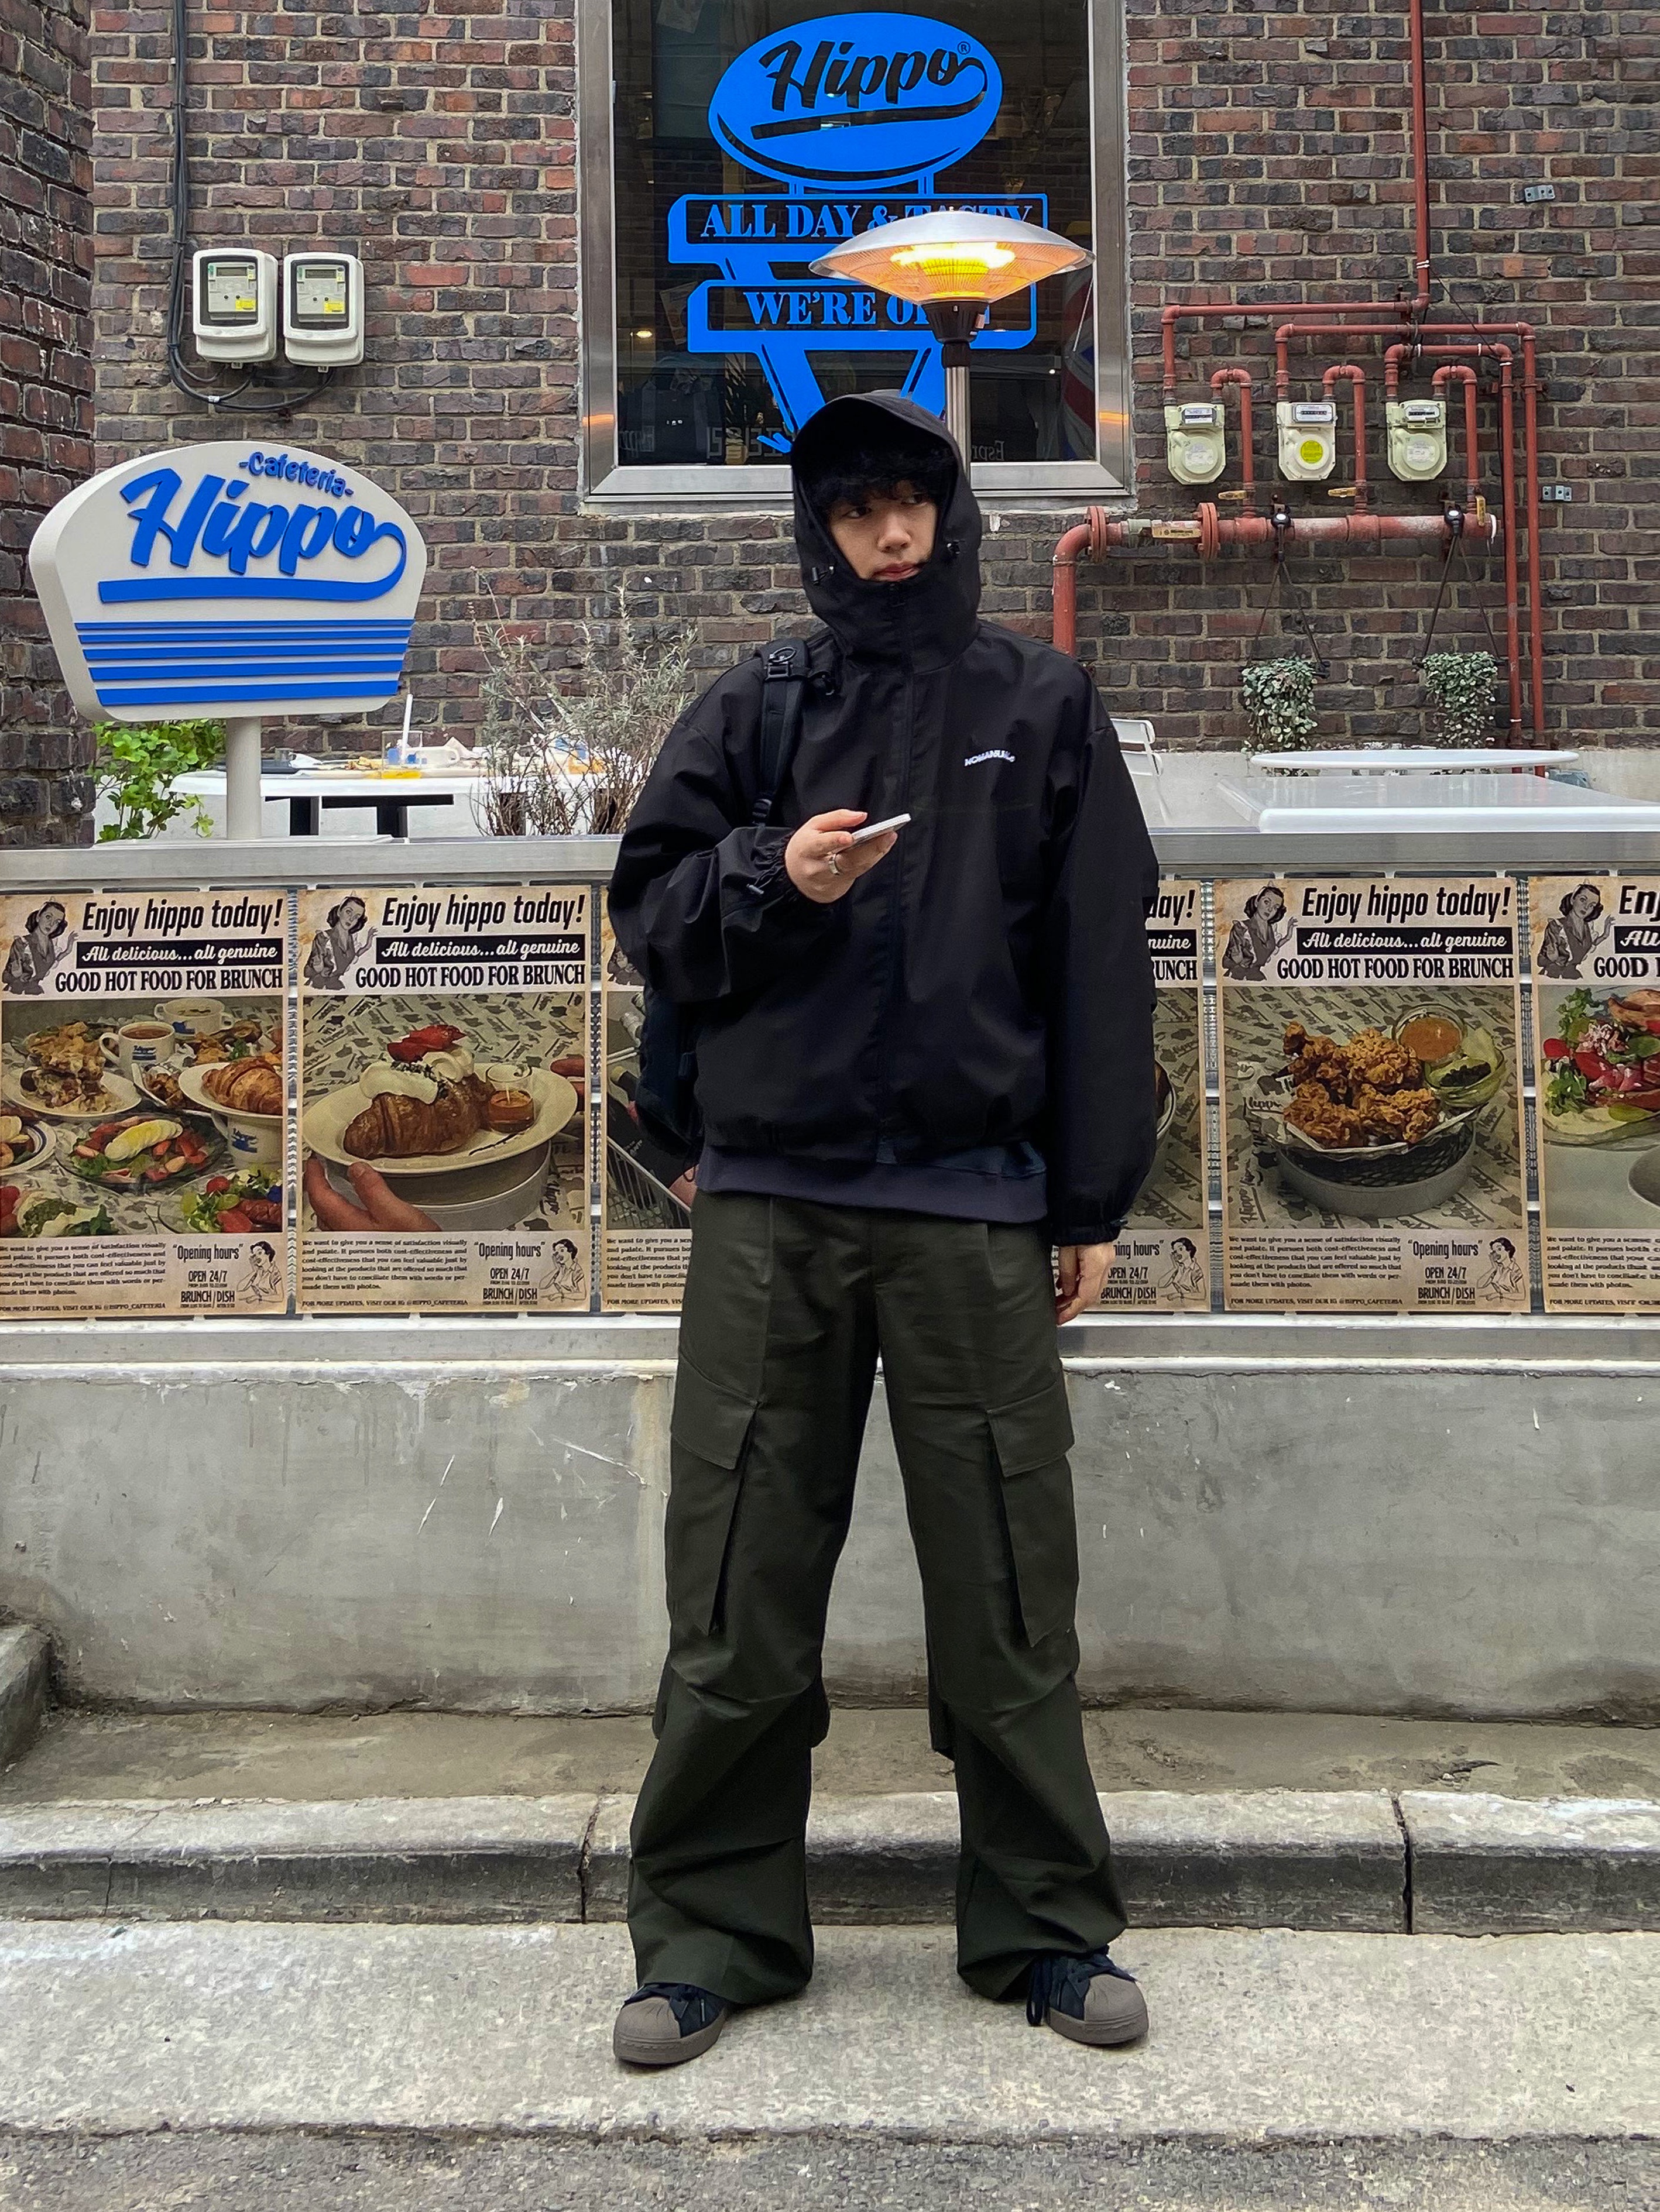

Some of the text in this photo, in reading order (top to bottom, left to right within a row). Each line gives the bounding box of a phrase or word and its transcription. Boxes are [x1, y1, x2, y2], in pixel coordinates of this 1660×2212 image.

[759, 40, 973, 112] Hippo
[701, 205, 776, 238] ALL
[786, 205, 862, 238] DAY
[743, 292, 876, 325] WE’RE
[120, 468, 389, 576] Hippo
[382, 892, 585, 933] Enjoy hippo today!
[1301, 884, 1511, 925] Enjoy hippo today!
[83, 897, 284, 937] Enjoy hippo today!
[381, 940, 410, 958] All
[520, 940, 581, 961] genuine
[1302, 933, 1330, 949] All
[1445, 932, 1507, 953] genuine
[82, 944, 109, 962] All
[218, 944, 278, 964] genuine
[356, 964, 585, 988] GOOD HOT FOOD FOR BRUNCH
[1153, 960, 1198, 981] UNCH
[1277, 958, 1514, 979] GOOD HOT FOOD FOR BRUNCH
[1594, 957, 1649, 978] GOOD
[56, 968, 283, 992] GOOD HOT FOOD FOR BRUNCH
[188, 1270, 228, 1283] OPEN 24/7
[490, 1267, 530, 1280] OPEN 24/7
[1129, 1266, 1148, 1279] 24/7
[1425, 1266, 1467, 1279] OPEN 24/7
